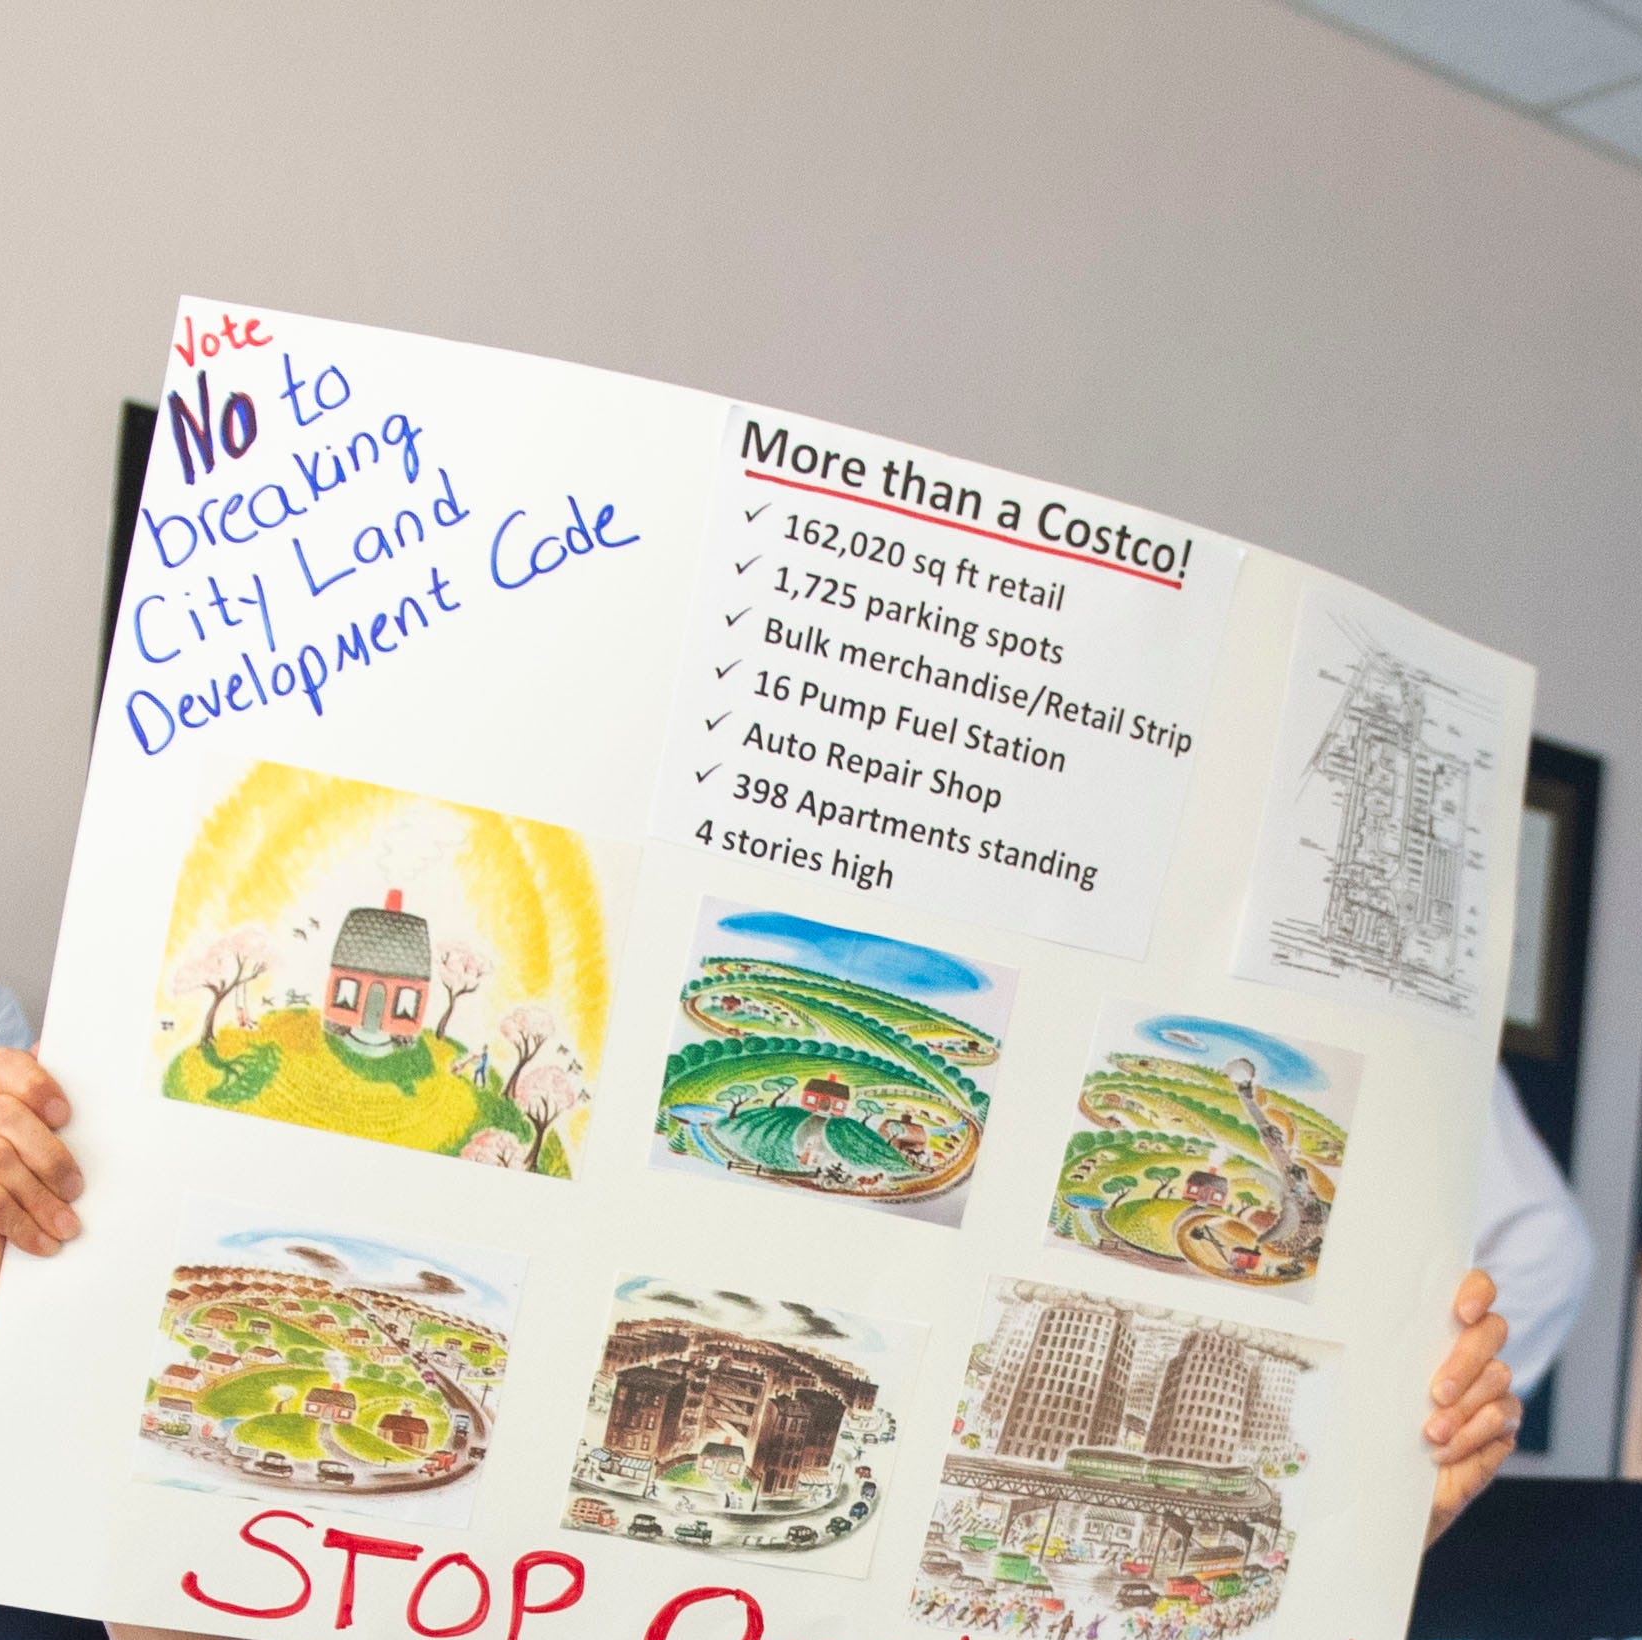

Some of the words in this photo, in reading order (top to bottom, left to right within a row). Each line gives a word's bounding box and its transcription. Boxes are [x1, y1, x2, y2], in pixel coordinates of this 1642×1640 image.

[174, 314, 273, 367] Vote
[167, 369, 257, 485] No
[279, 352, 352, 427] to
[142, 413, 423, 569] breaking
[740, 420, 867, 487] More
[882, 460, 982, 521] than
[997, 498, 1022, 531] a
[1037, 502, 1194, 580] Costco!
[133, 573, 276, 664] City
[292, 467, 470, 597] Land
[773, 565, 858, 610] 1,725
[864, 592, 980, 648] parking
[985, 624, 1065, 666] spots
[783, 513, 906, 569] 162,020
[912, 548, 946, 587] sq
[955, 556, 980, 590] ft
[987, 572, 1067, 612] retail
[126, 567, 462, 757] Development
[489, 495, 641, 589] Code
[753, 668, 792, 702] 16
[799, 680, 888, 732] Pump
[895, 704, 958, 745] Fuel
[963, 722, 1067, 775] Station
[763, 616, 832, 660] Bulk
[839, 637, 1126, 736] merchandise/Retail
[1129, 713, 1194, 758] Strip
[742, 721, 818, 762] Auto
[825, 742, 924, 789] Repair
[929, 769, 1003, 811] Shop
[694, 818, 714, 847] 4
[721, 827, 824, 874] stories
[831, 849, 896, 891] high
[732, 772, 789, 810] 398
[795, 789, 971, 855] Apartments
[977, 836, 1100, 892] standing
